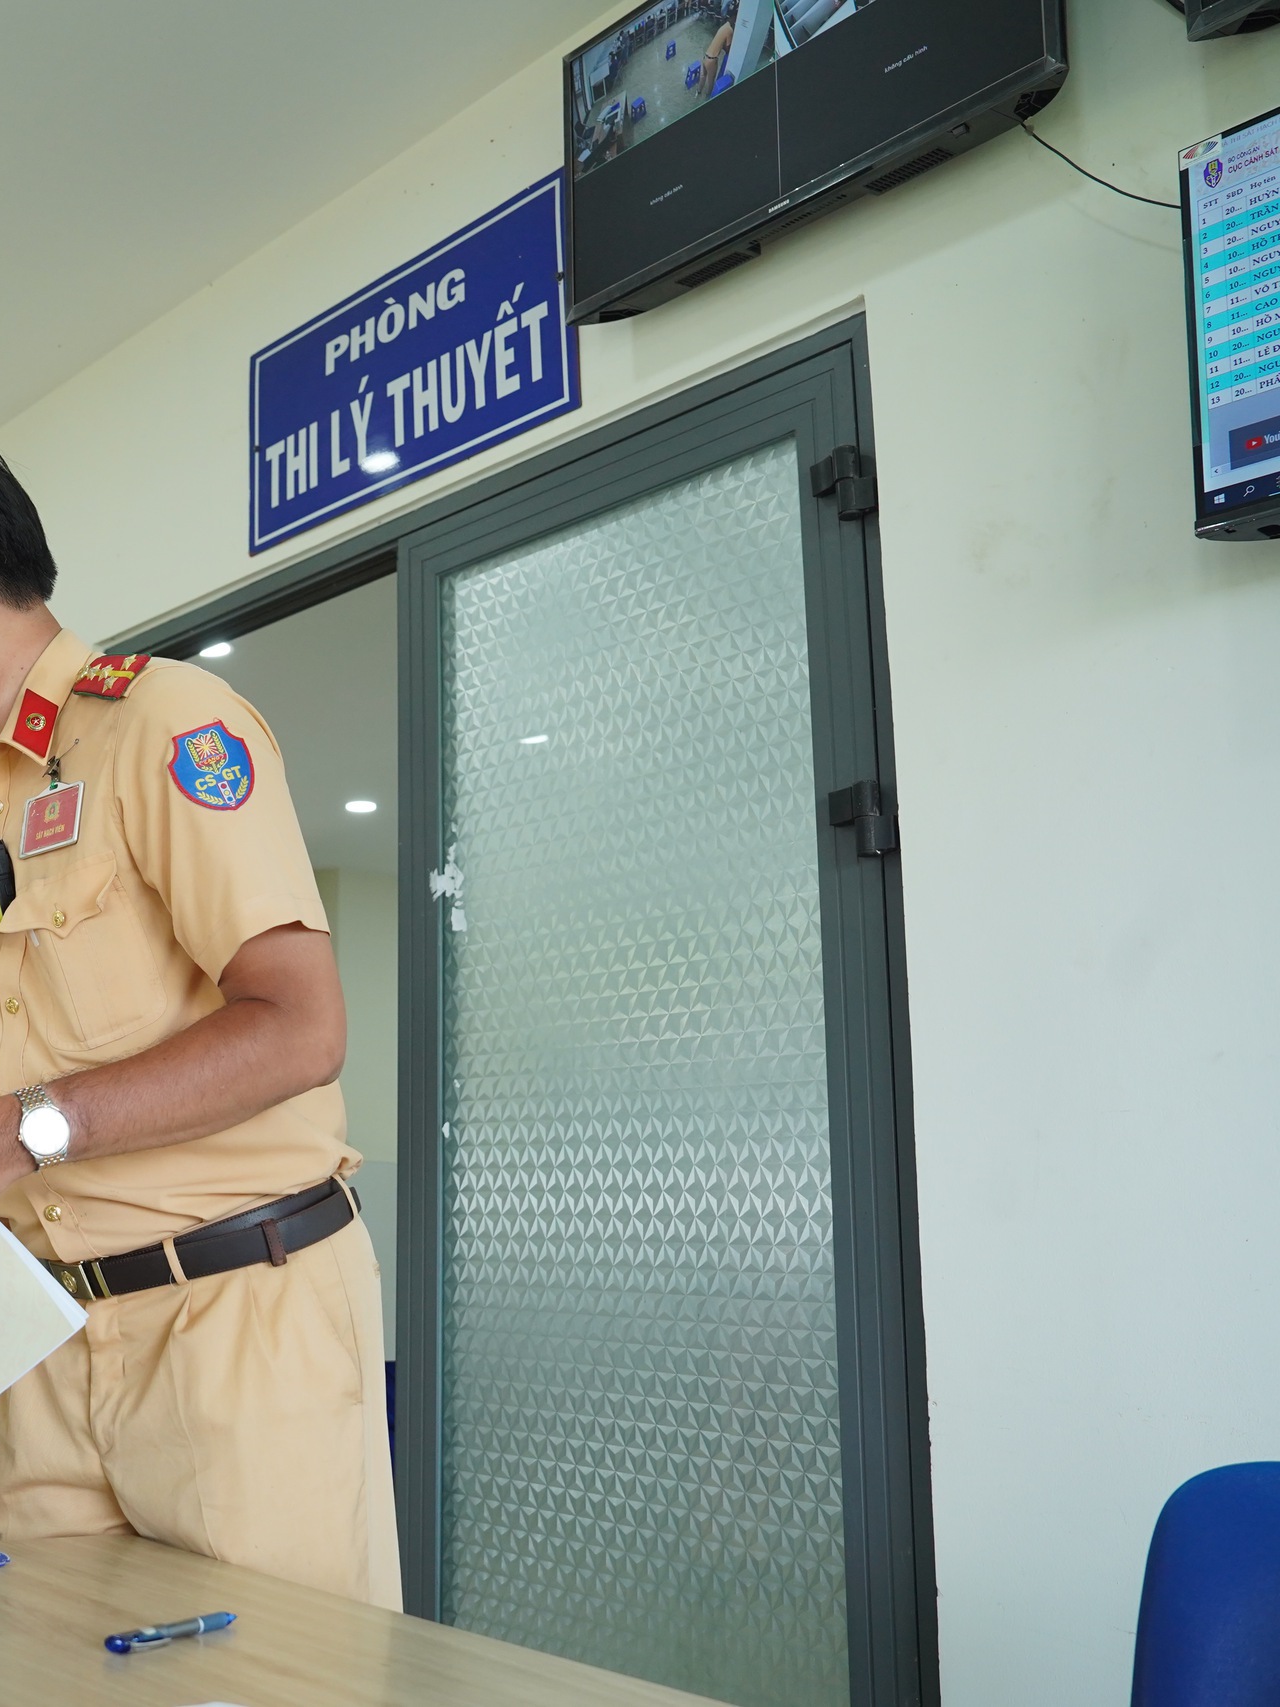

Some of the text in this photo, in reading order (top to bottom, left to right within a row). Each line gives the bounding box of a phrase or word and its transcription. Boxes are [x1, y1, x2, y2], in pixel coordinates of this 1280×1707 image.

[1226, 188, 1243, 200] SBD
[769, 199, 789, 213] SAMSUNG
[1203, 198, 1219, 209] STT
[1202, 232, 1208, 240] 2
[1204, 276, 1209, 284] 5
[1205, 291, 1210, 299] 6
[1255, 298, 1278, 311] CAO
[1206, 306, 1211, 314] 7
[325, 268, 465, 376] PHÒNG
[1207, 336, 1212, 344] 9
[1209, 350, 1218, 358] 10
[1210, 366, 1218, 374] 11
[1210, 380, 1220, 390] 12
[265, 282, 548, 509] THI LÝ THUYẾT
[1211, 396, 1220, 405] 13
[1264, 432, 1280, 444] You
